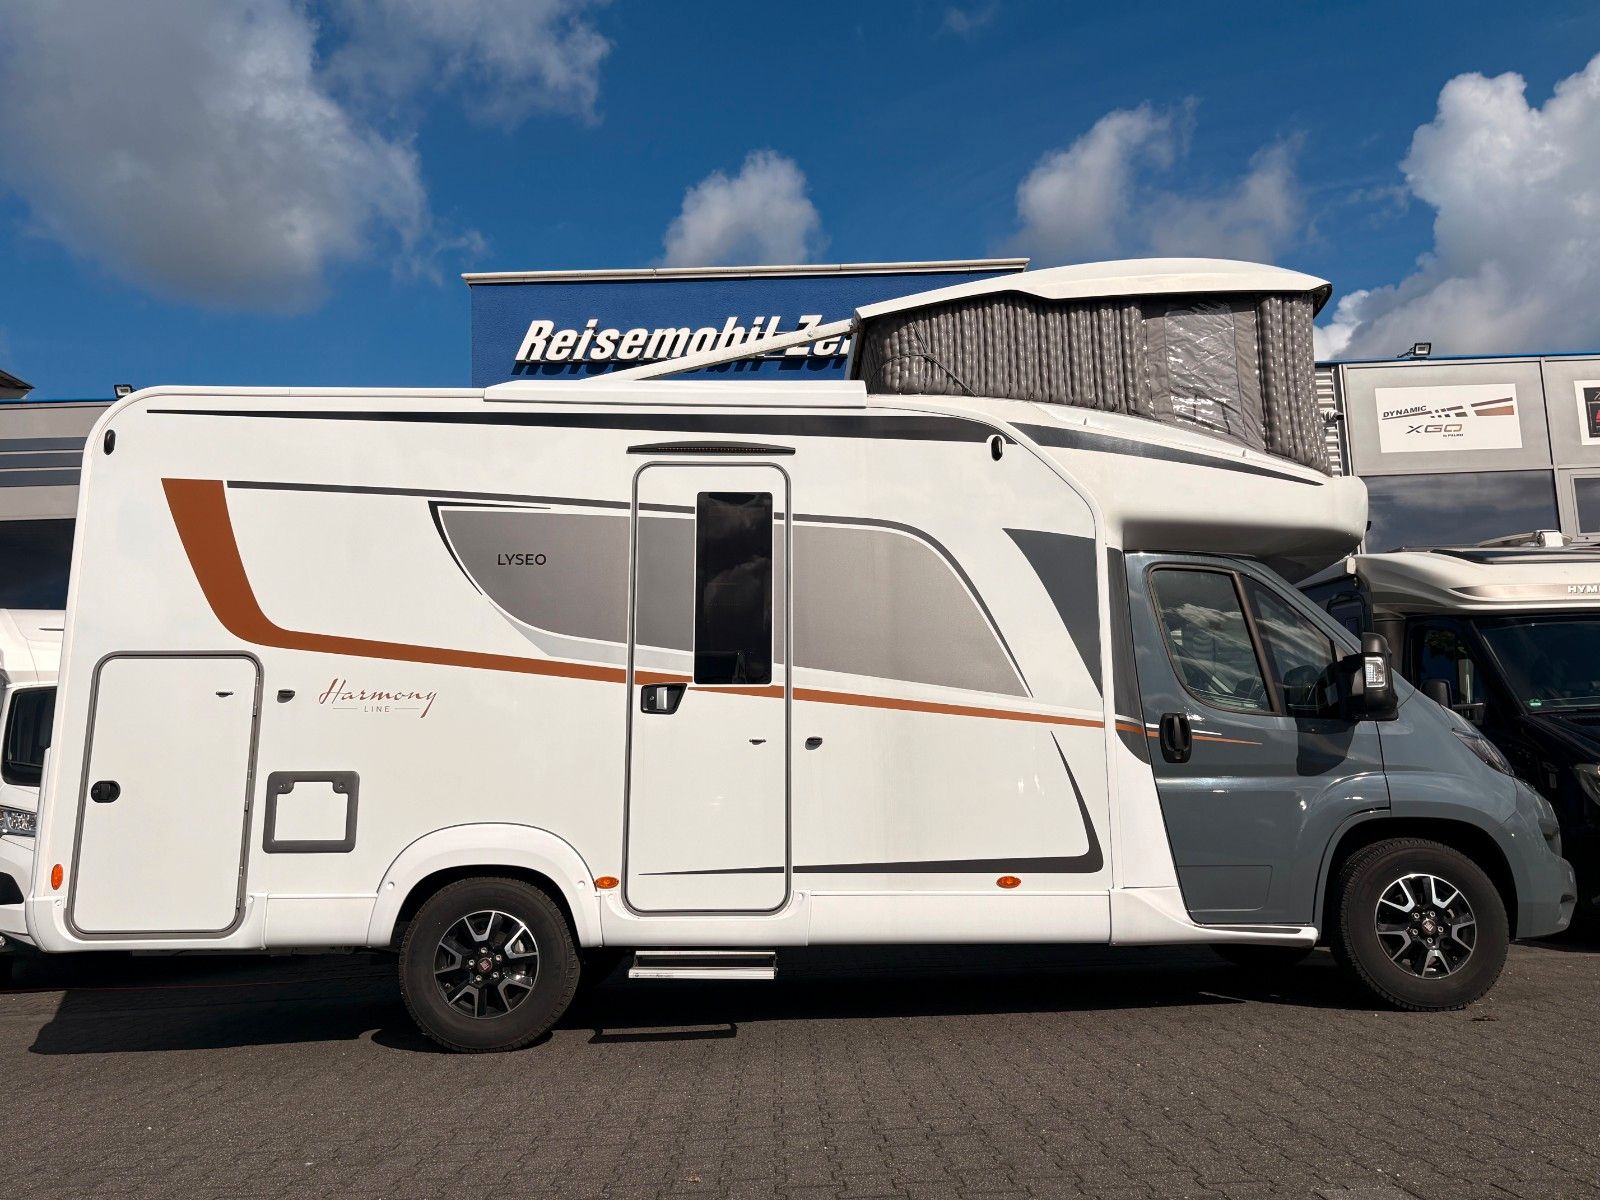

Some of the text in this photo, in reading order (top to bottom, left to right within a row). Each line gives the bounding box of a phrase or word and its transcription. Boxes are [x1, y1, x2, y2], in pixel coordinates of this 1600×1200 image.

[515, 316, 780, 361] Reisemobil
[1383, 405, 1427, 418] DYNAMIC
[1405, 424, 1463, 434] XGO
[497, 553, 547, 566] LYSEO
[1567, 584, 1600, 594] HYM
[318, 678, 438, 719] Harmony
[363, 705, 391, 713] LINE
